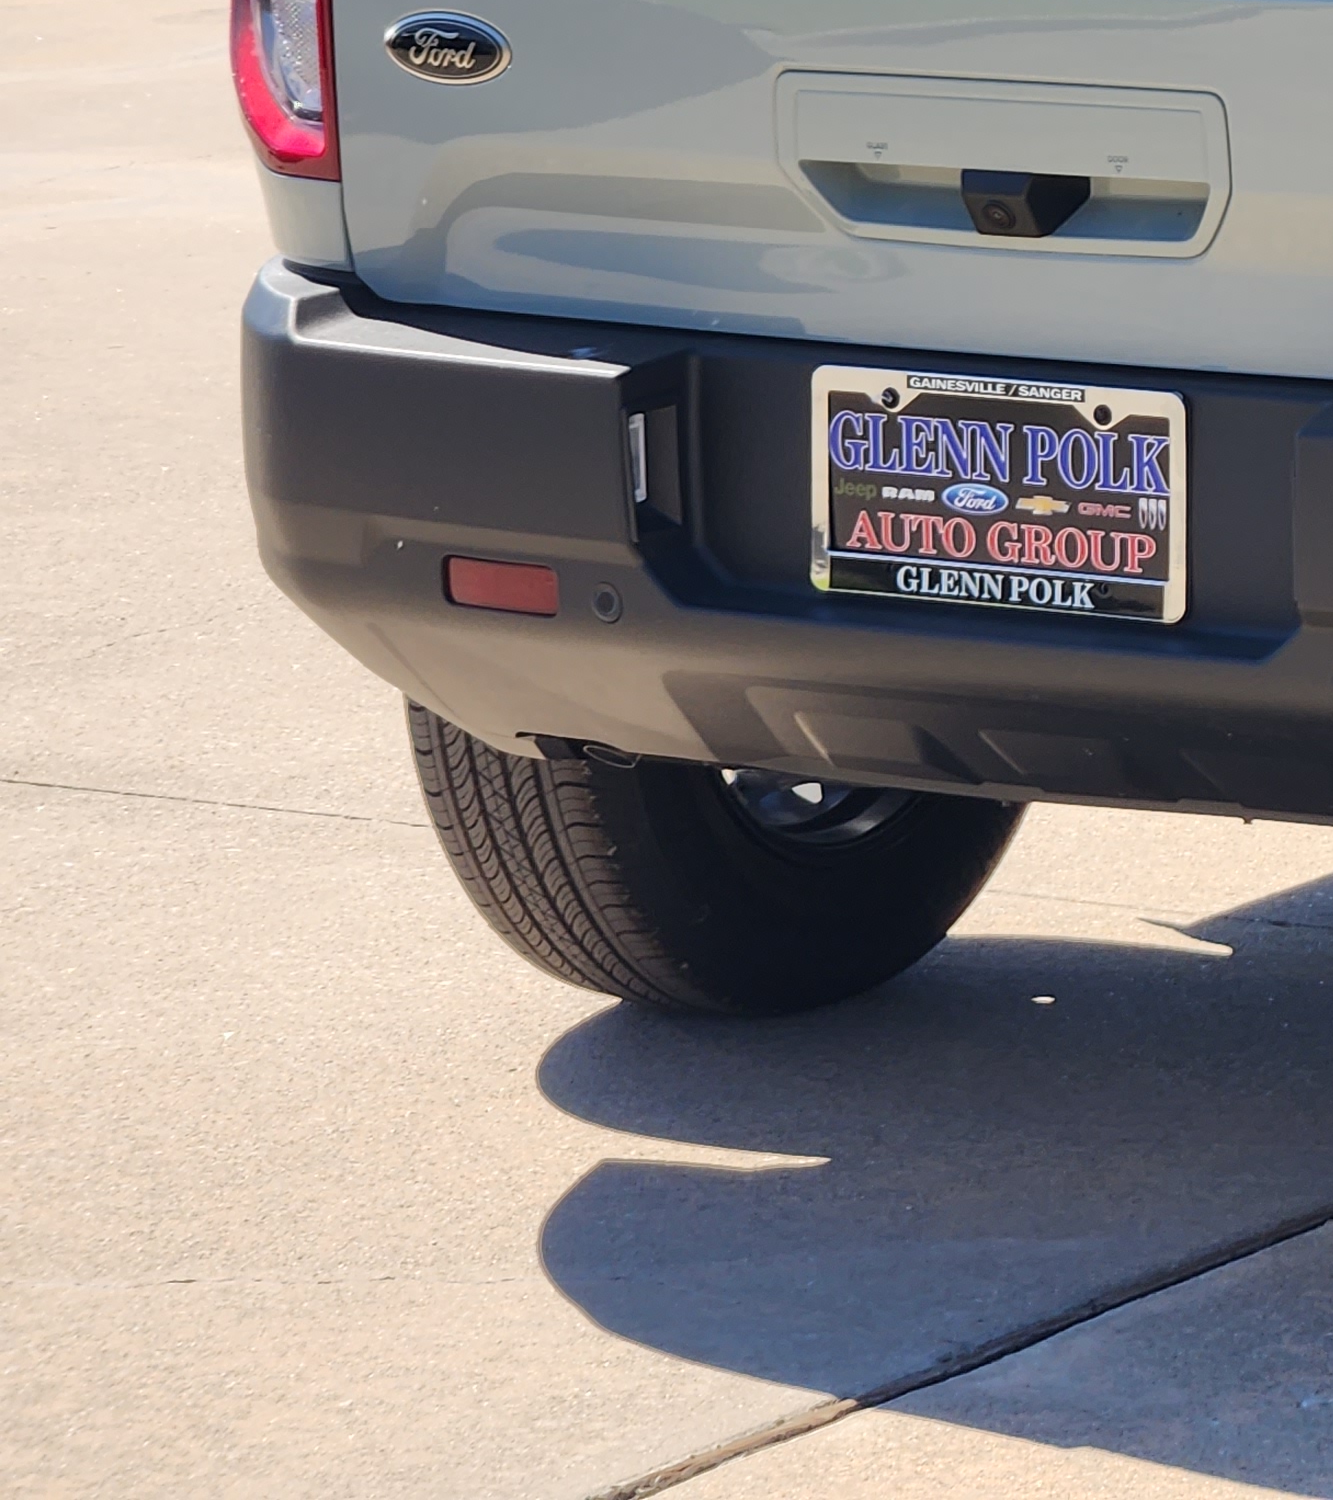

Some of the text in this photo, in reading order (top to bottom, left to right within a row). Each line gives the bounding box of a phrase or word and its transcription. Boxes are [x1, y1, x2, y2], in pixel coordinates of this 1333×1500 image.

[401, 26, 477, 69] Ford
[909, 376, 1007, 396] GAINESVILLE
[1018, 385, 1083, 401] SANGER
[829, 409, 1171, 496] GLENN POLK
[835, 478, 1132, 519] Jeep RAM Ford GMC
[846, 510, 1157, 574] AUTO GROUP
[896, 565, 1096, 610] GLENN POLK
